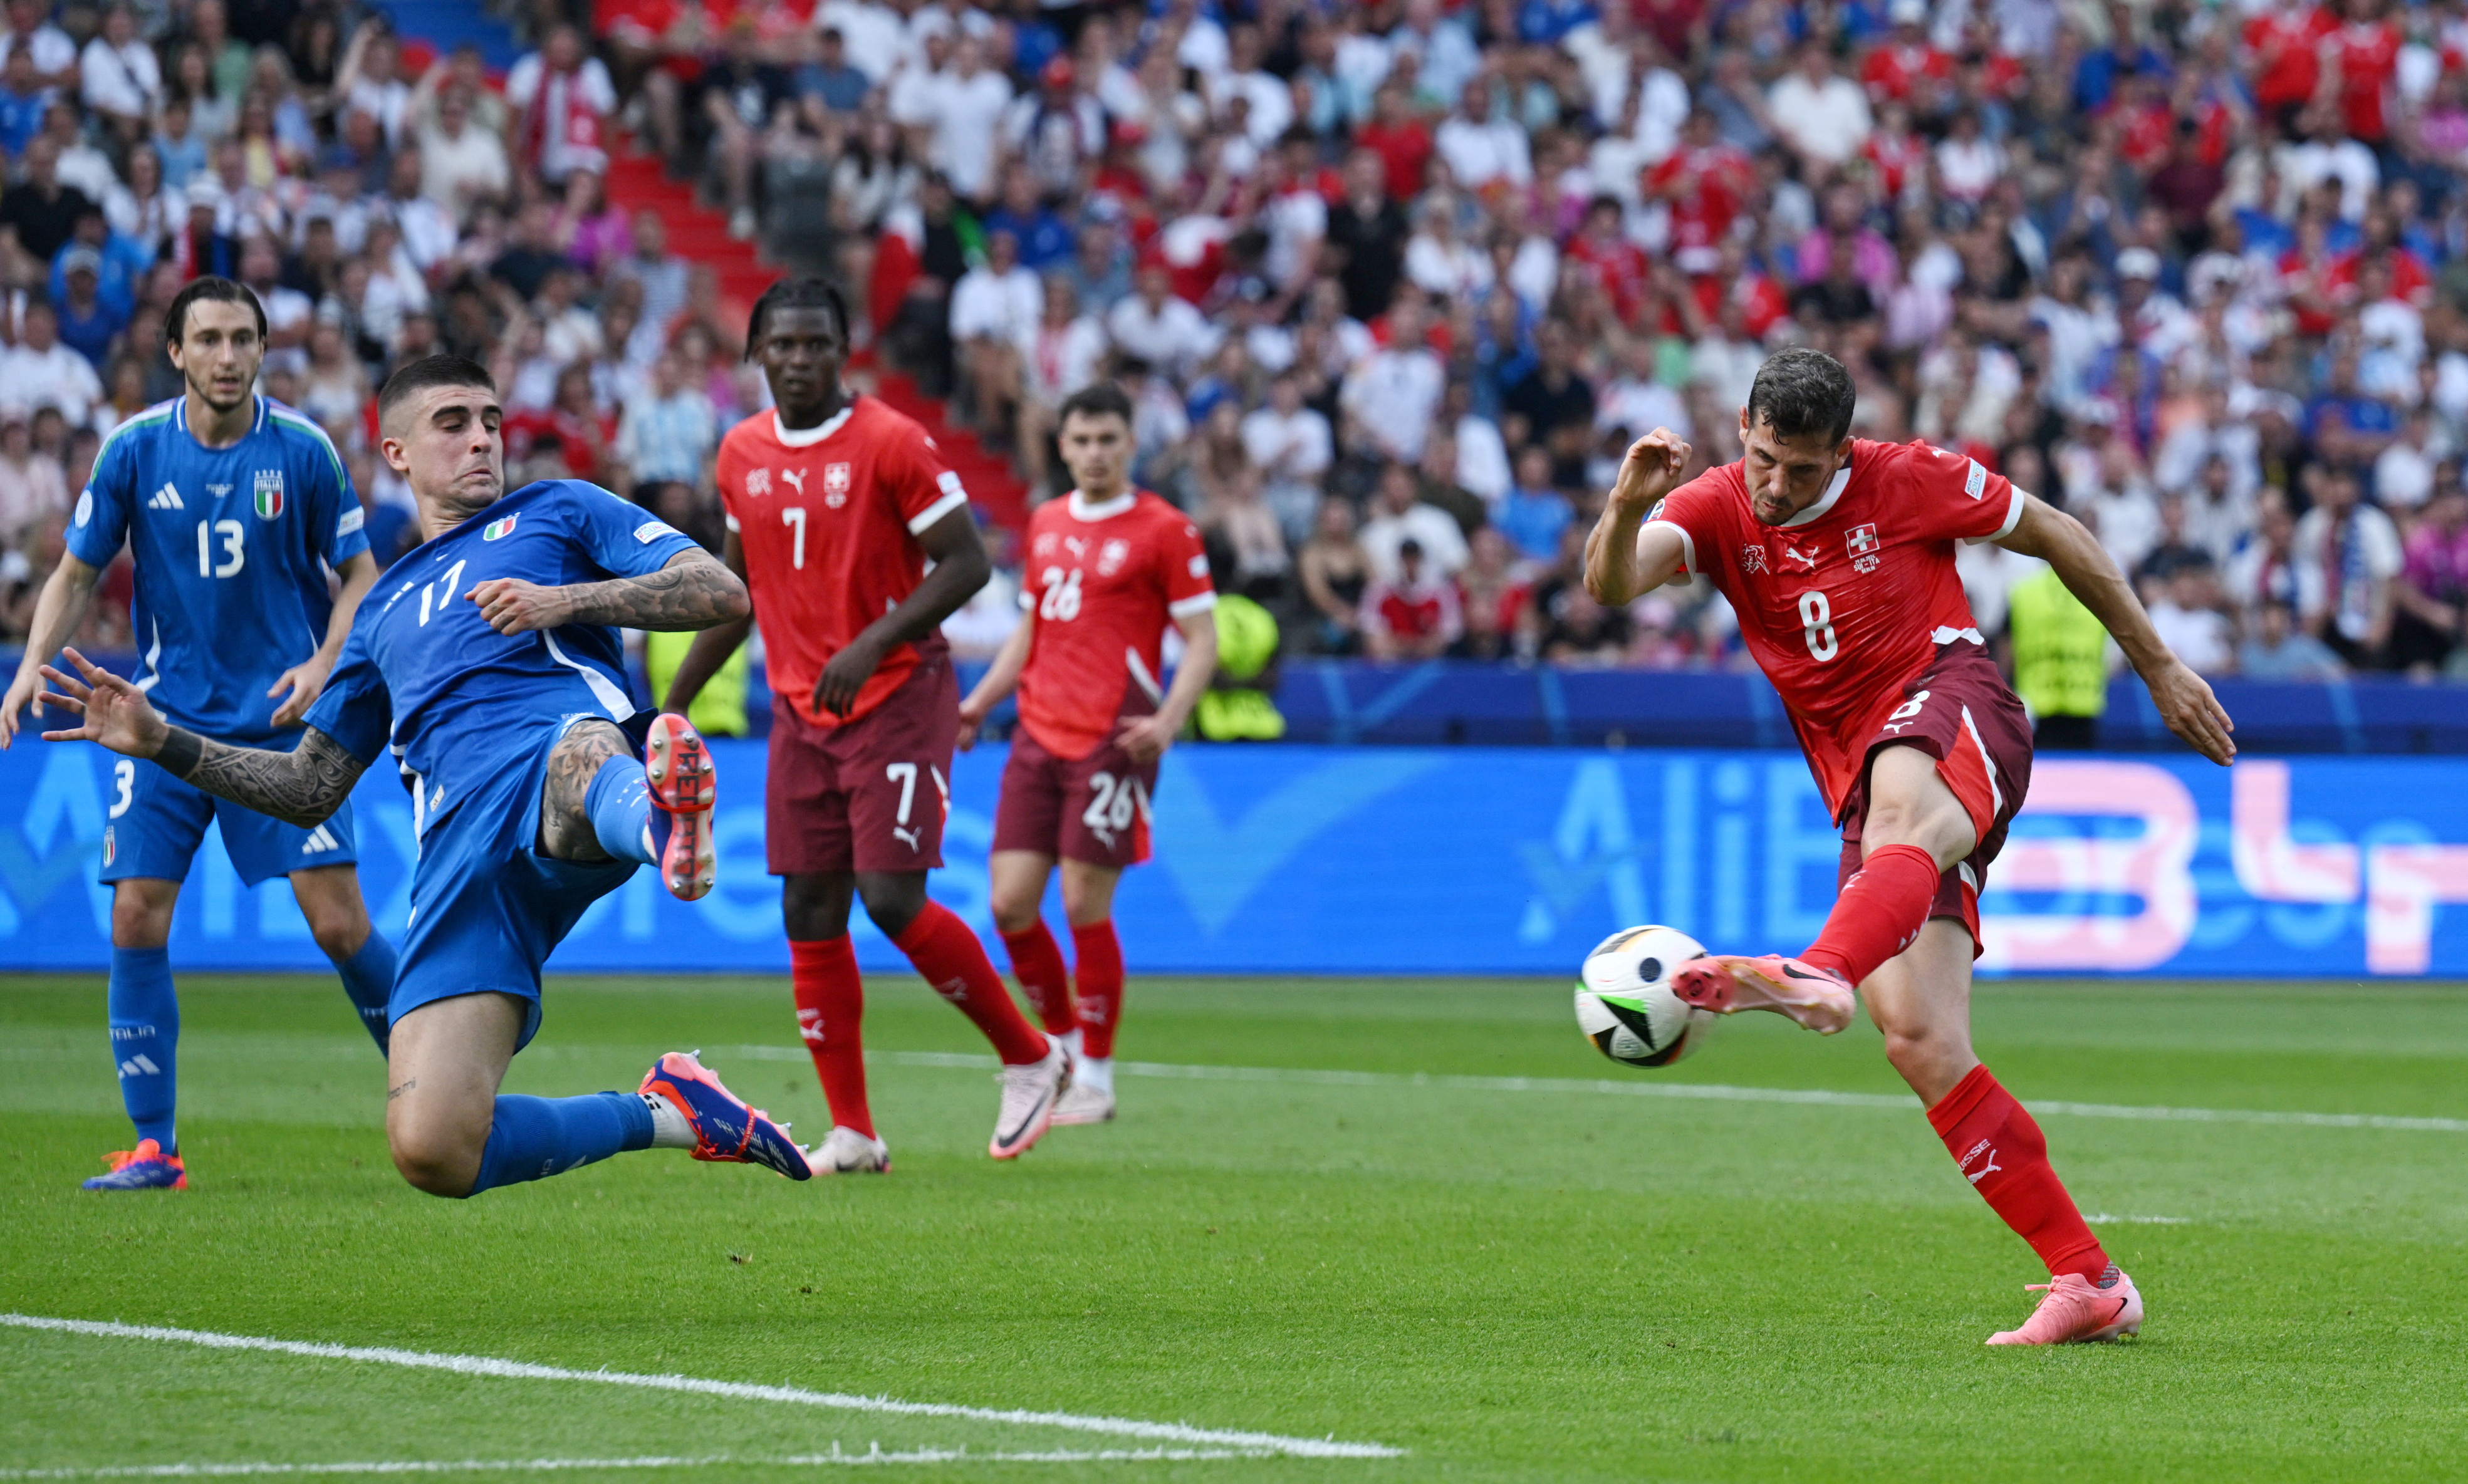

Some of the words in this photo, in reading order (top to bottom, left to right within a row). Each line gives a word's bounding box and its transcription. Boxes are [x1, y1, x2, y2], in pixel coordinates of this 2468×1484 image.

[256, 479, 281, 492] ITALIA
[197, 519, 244, 579] 13
[781, 507, 806, 570] 7
[1853, 563, 1864, 571] SUI
[1869, 557, 1880, 566] ITA
[419, 554, 466, 627] 17
[1039, 564, 1083, 622] 26
[1861, 565, 1876, 574] BERLIN
[1798, 590, 1838, 662] 8
[886, 762, 919, 826] 7
[1082, 771, 1132, 831] 26
